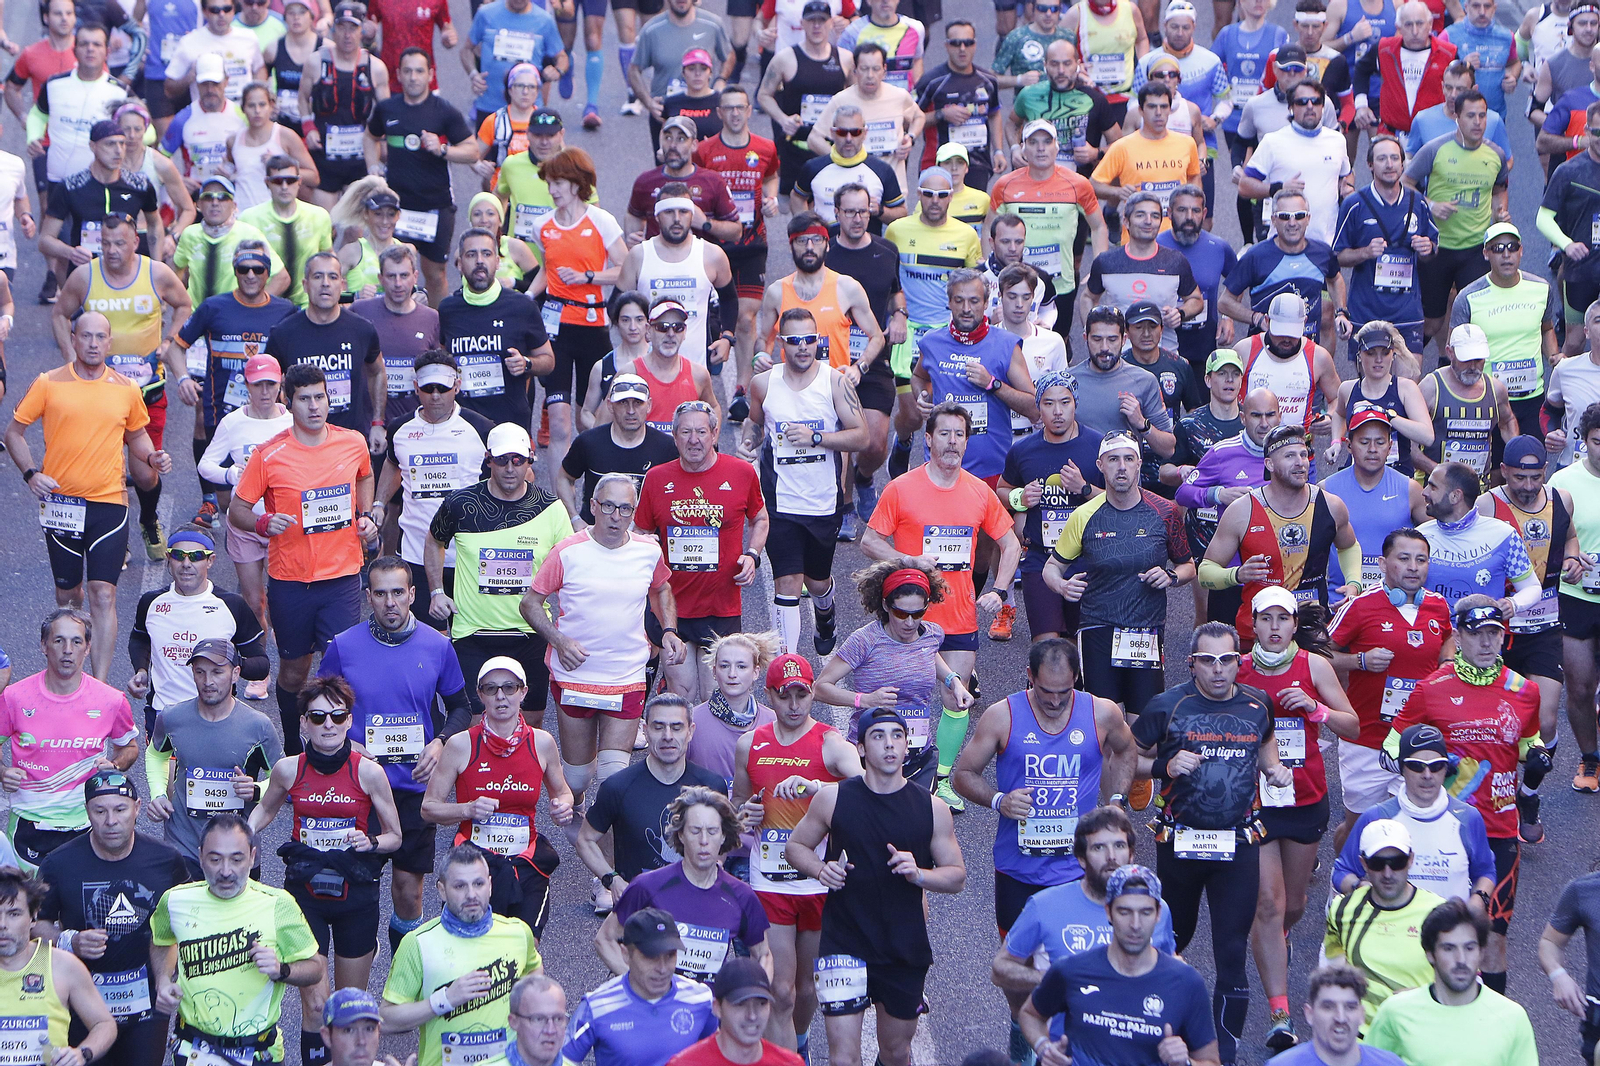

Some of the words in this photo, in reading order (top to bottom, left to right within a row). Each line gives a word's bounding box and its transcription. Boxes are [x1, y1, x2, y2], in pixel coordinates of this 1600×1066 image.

[680, 109, 712, 117] PENNY
[869, 122, 892, 131] ZURICH
[1136, 159, 1183, 170] MATAOS
[1030, 246, 1056, 254] ZURICH
[665, 279, 693, 288] ZURICH
[89, 298, 132, 311] TONY
[1487, 302, 1537, 319] MOROCCO
[451, 335, 502, 354] HITACHI
[386, 359, 413, 367] ZURICH
[468, 356, 498, 364] ZURICH
[1506, 361, 1532, 369] ZURICH
[468, 369, 492, 380] 10668
[472, 381, 488, 389] HULK
[1506, 376, 1527, 385] 10174
[955, 394, 982, 403] ZURICH
[408, 432, 424, 440] edp
[796, 448, 807, 456] ASU
[424, 455, 453, 464] ZURICH
[424, 472, 448, 480] 10462
[420, 482, 434, 490] RAY
[435, 481, 452, 489] PALMA
[317, 487, 346, 497] ZURICH
[318, 504, 339, 513] 9840
[51, 510, 73, 519] 10414
[315, 515, 342, 523] GONZALO
[45, 520, 58, 528] JOSE
[58, 521, 77, 529] MUÑOZ
[683, 529, 713, 537] ZURICH
[941, 529, 967, 537] ZURICH
[683, 545, 704, 554] 9072
[937, 545, 962, 553] 11677
[1431, 543, 1492, 561] ATINUM
[497, 551, 528, 559] ZURICH
[1362, 556, 1379, 564] ZUR
[496, 568, 518, 576] 8153
[1362, 571, 1383, 580] 8824
[155, 602, 172, 614] edp
[1527, 608, 1546, 616] 7687
[172, 631, 198, 643] edp
[1129, 640, 1150, 649] 9659
[385, 715, 418, 725] ZURICH
[385, 734, 408, 745] 9438
[1475, 735, 1496, 743] LUNA
[387, 746, 405, 754] SEBA
[1200, 745, 1217, 760] Los
[1218, 747, 1247, 762] tigres
[16, 759, 49, 772] chiclana
[756, 756, 811, 767] ESPAÑA
[1025, 754, 1081, 778] RCM
[206, 770, 237, 779] ZURICH
[1492, 771, 1517, 786] RUN
[204, 787, 228, 798] 9439
[1491, 785, 1516, 798] NING
[1035, 787, 1078, 806] 873
[205, 800, 225, 808] WILLY
[1037, 807, 1072, 817] ZURICH
[316, 819, 352, 829] ZURICH
[489, 816, 523, 827] ZURICH
[1034, 825, 1063, 834] 12313
[487, 834, 515, 844] 11276
[1022, 836, 1042, 846] FRAN
[1042, 837, 1074, 846] CARRERA
[1194, 833, 1218, 841] 9140
[315, 838, 342, 847] 11277
[105, 916, 139, 926] Reebok
[690, 929, 723, 941] ZURICH
[181, 936, 249, 964] TORTUGAS
[683, 947, 712, 959] 11440
[678, 961, 707, 970] JACQUIE
[827, 959, 859, 969] ZURICH
[188, 963, 206, 976] DEL
[106, 971, 141, 984] ZURICH
[825, 978, 852, 987] 11712
[1, 1019, 40, 1029] ZURICH
[1082, 1012, 1117, 1028] PAZITO
[1126, 1019, 1163, 1036] PAZITO
[462, 1032, 500, 1045] ZURICH
[1, 1040, 28, 1050] 8876
[13, 1054, 42, 1063] BARATA
